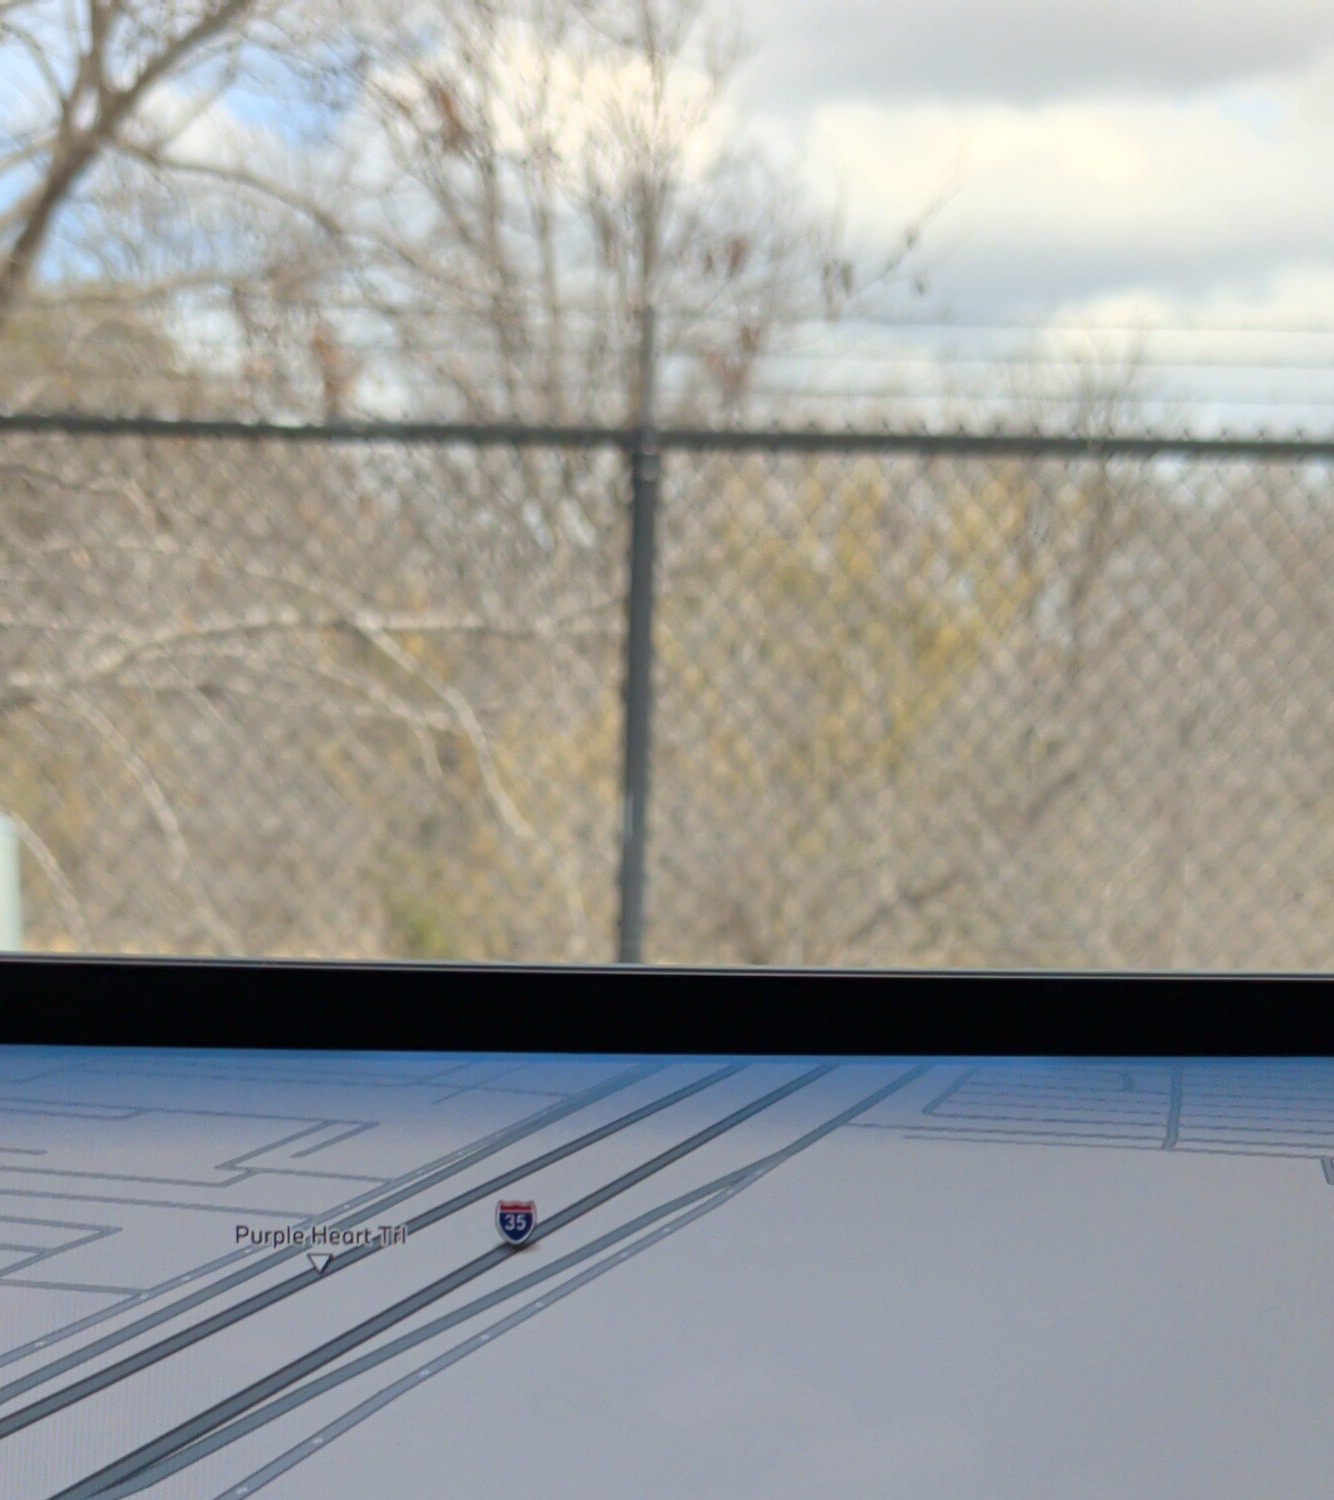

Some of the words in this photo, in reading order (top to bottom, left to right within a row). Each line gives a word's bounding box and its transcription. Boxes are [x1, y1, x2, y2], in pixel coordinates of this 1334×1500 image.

[505, 1212, 527, 1234] 35
[235, 1225, 304, 1248] Purple
[310, 1226, 372, 1247] Heart
